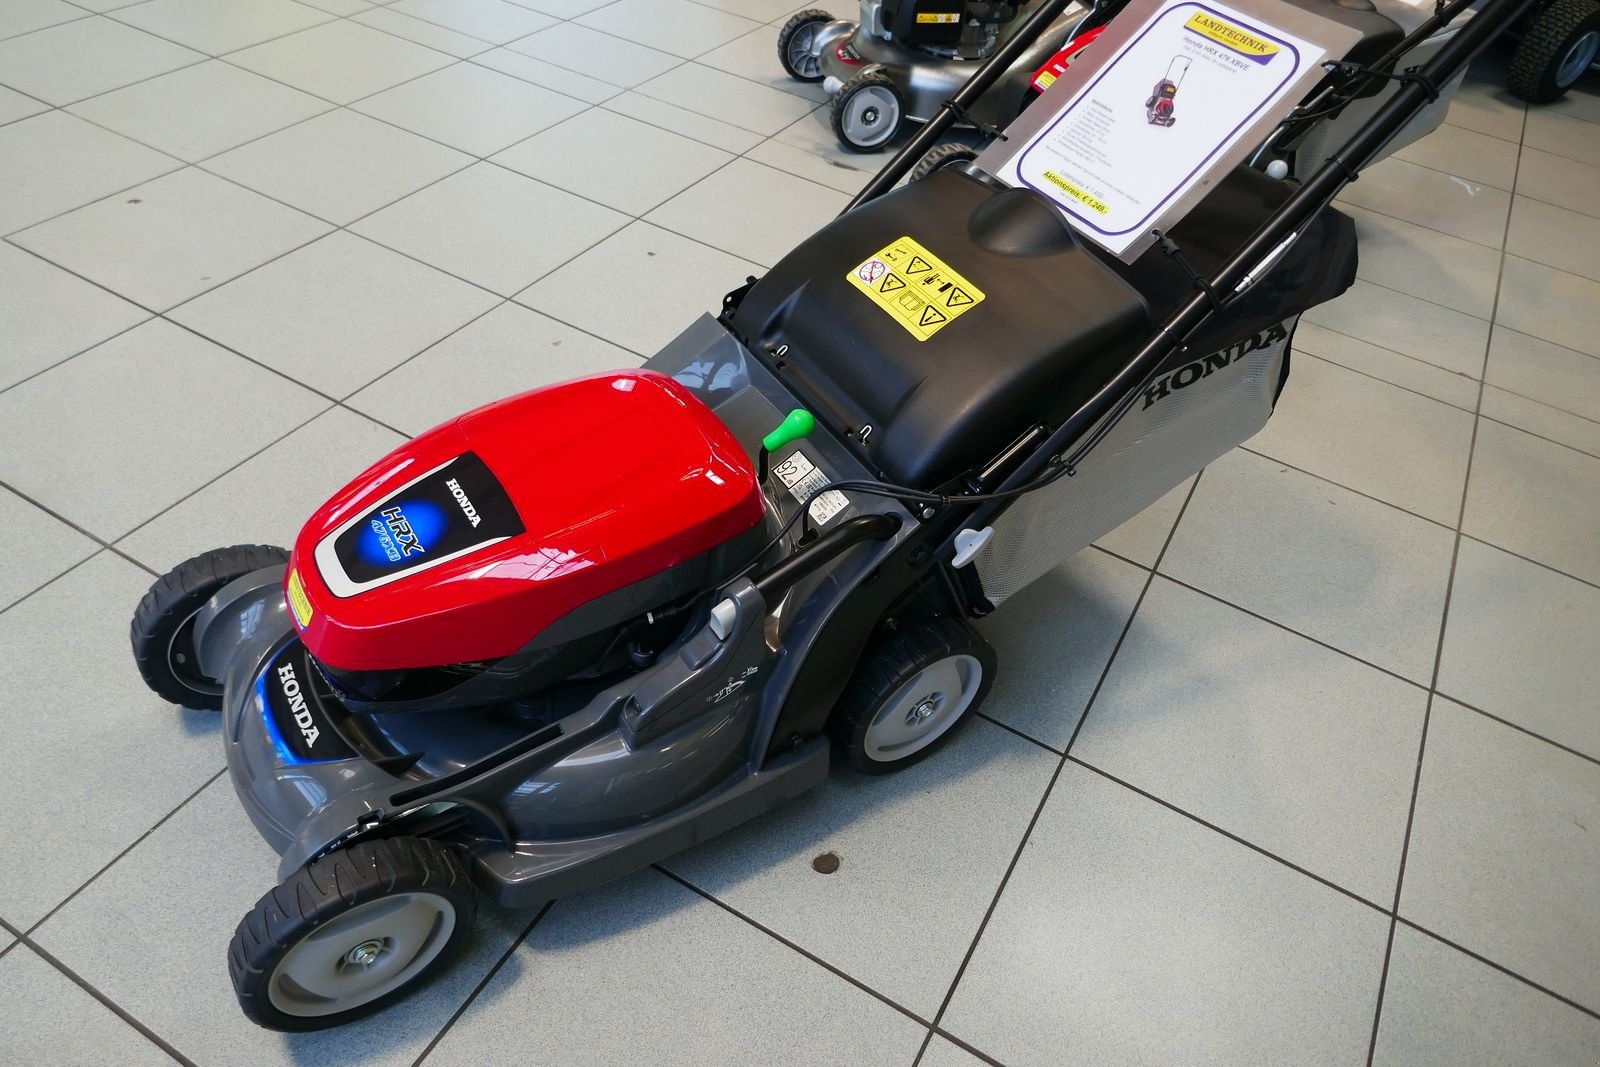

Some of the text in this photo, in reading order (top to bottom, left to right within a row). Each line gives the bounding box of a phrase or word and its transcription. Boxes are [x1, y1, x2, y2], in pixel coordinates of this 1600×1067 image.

[1183, 36, 1204, 49] Honda
[1204, 45, 1218, 56] HRX
[1219, 53, 1231, 63] 476
[1231, 59, 1250, 72] XBVE
[1194, 15, 1268, 53] LANDTECHNIK
[1043, 171, 1081, 199] Aktionspreis:
[1081, 194, 1089, 203] €
[1142, 322, 1287, 411] HONDA
[776, 460, 798, 481] 92
[445, 478, 482, 528] HONDA
[381, 506, 425, 557] HRX
[277, 662, 320, 748] HONDA
